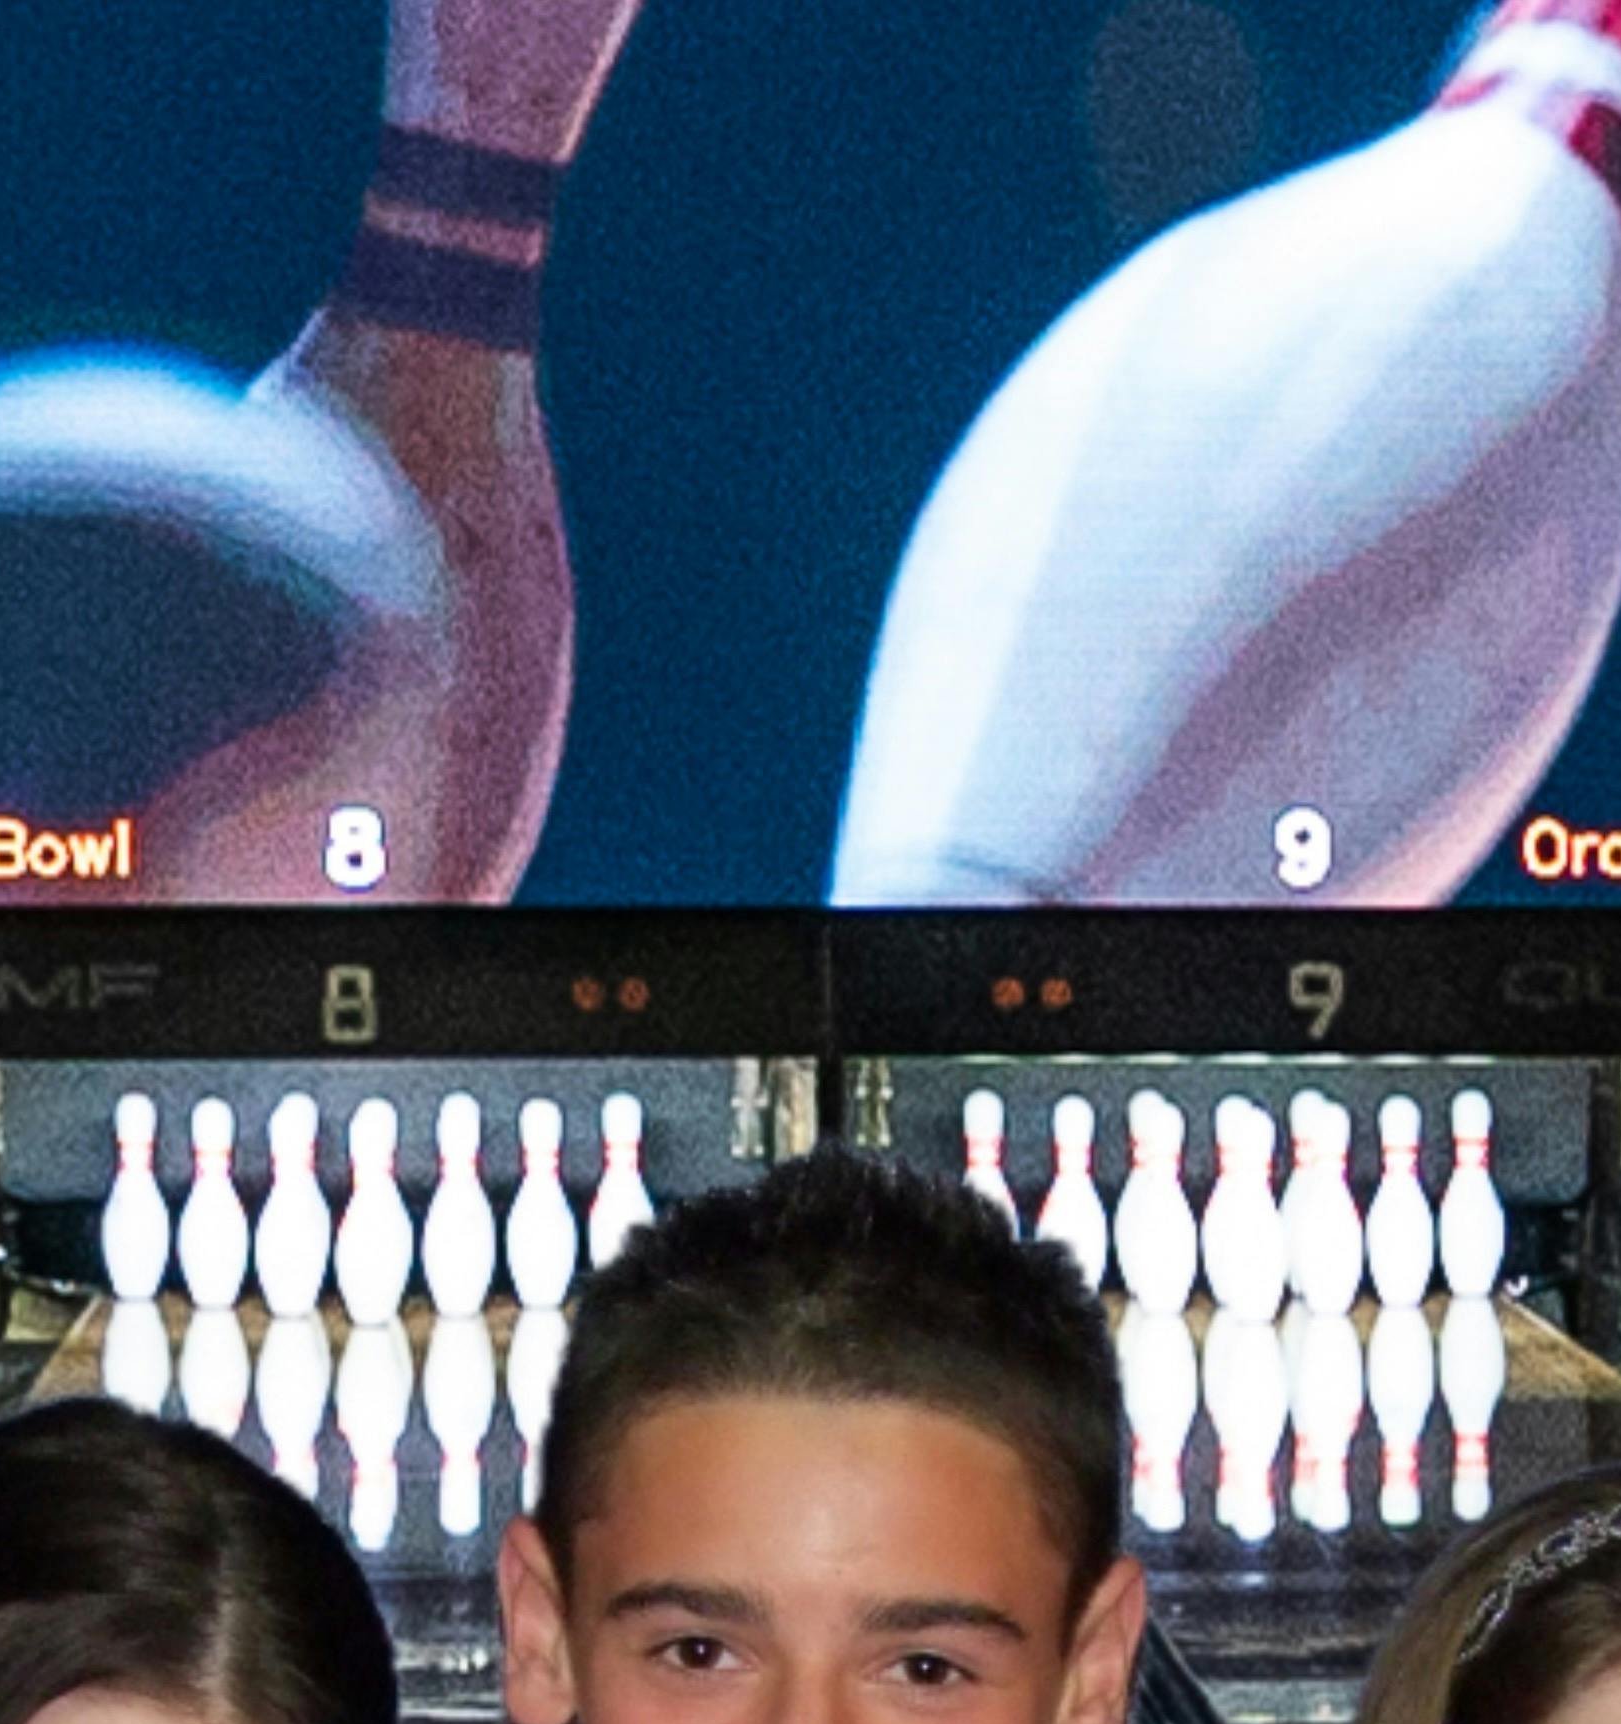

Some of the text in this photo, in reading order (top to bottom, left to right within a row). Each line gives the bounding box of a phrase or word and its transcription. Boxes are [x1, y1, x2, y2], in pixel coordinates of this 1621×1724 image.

[325, 808, 386, 887] 8
[1275, 808, 1331, 887] 9
[323, 964, 376, 1042] 8
[1289, 961, 1344, 1039] 9
